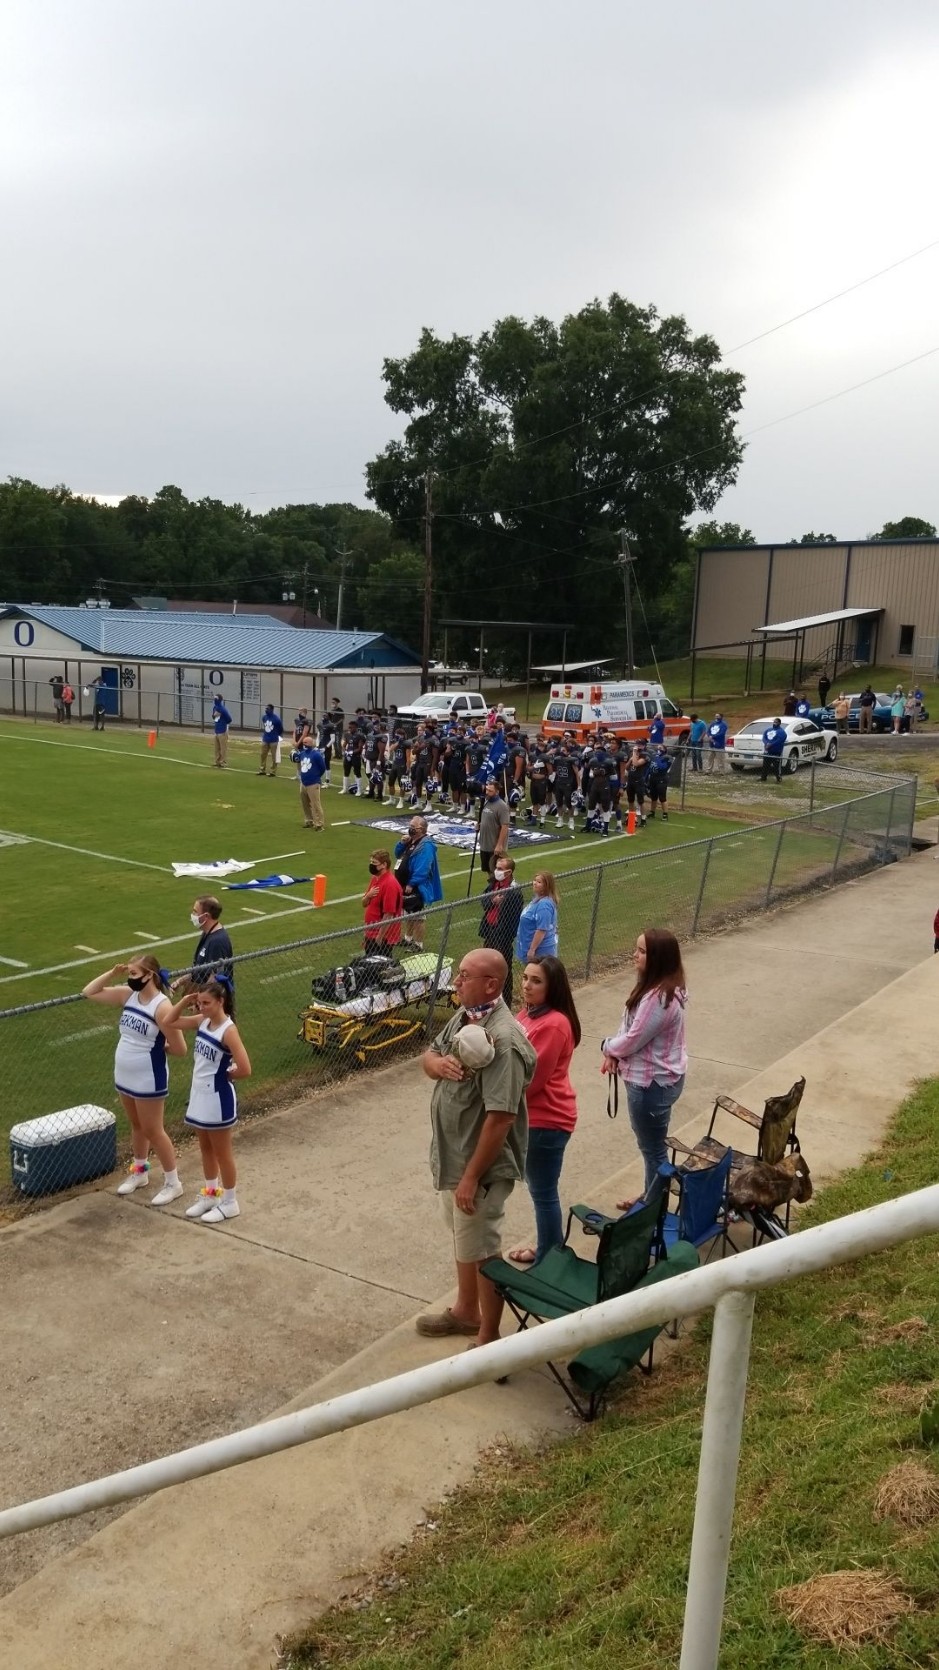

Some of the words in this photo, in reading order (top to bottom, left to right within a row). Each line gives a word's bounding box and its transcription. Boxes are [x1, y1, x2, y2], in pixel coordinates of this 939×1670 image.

[14, 620, 34, 646] O
[209, 670, 224, 686] O
[120, 1014, 148, 1035] AKMAN
[195, 1040, 216, 1062] KMAN
